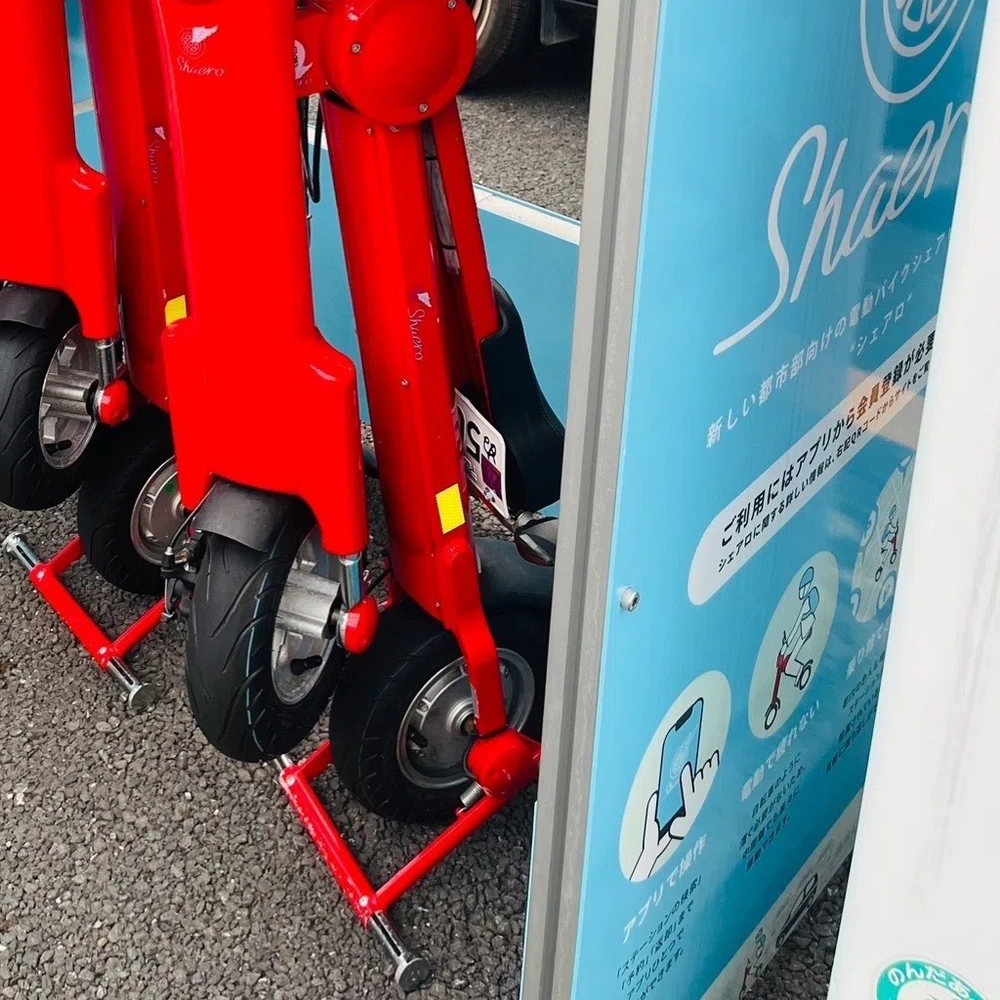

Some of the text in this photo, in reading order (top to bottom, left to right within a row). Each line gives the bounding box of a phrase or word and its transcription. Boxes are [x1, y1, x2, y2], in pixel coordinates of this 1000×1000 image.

[706, 228, 951, 449] 新しい都市部向けの電動バイクシェア
